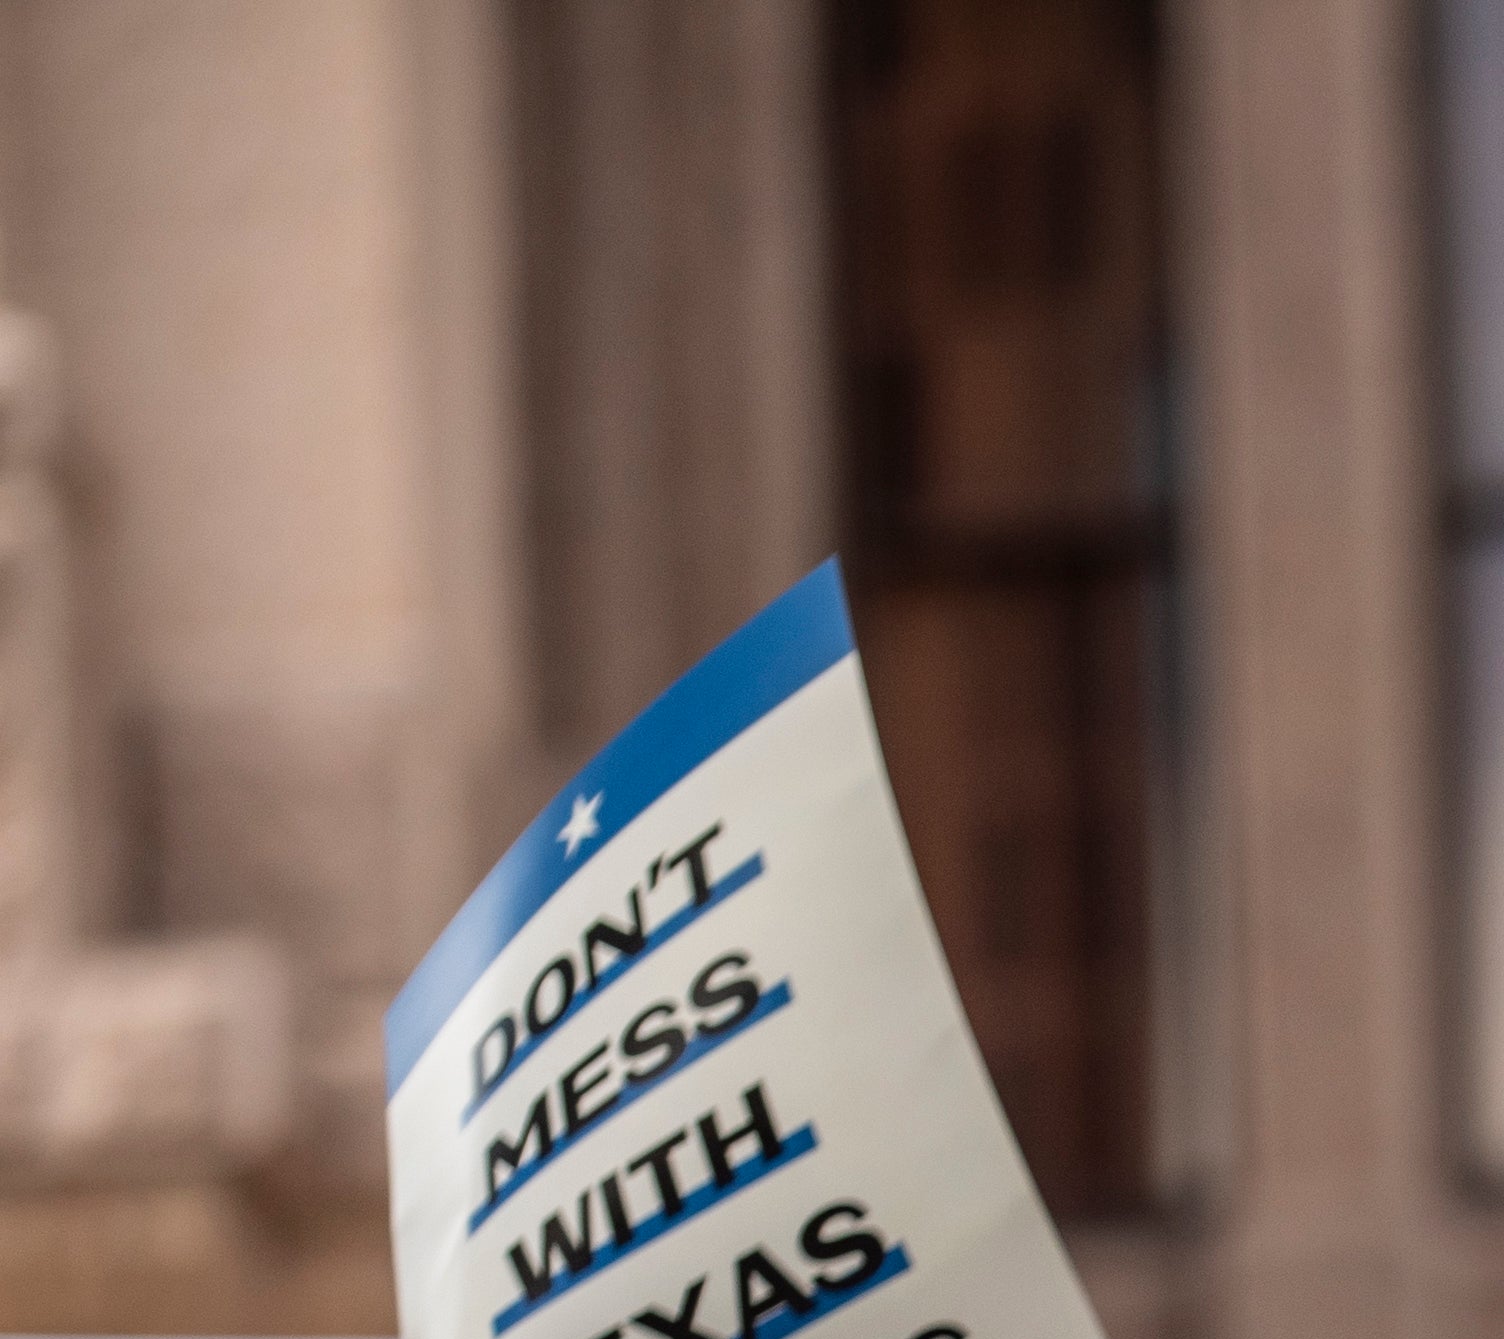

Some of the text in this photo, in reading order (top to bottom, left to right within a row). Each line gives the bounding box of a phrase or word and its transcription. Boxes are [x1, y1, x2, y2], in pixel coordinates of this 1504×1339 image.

[471, 820, 724, 1100] DON'T
[483, 950, 762, 1203] MESS
[507, 1080, 784, 1299] WITH
